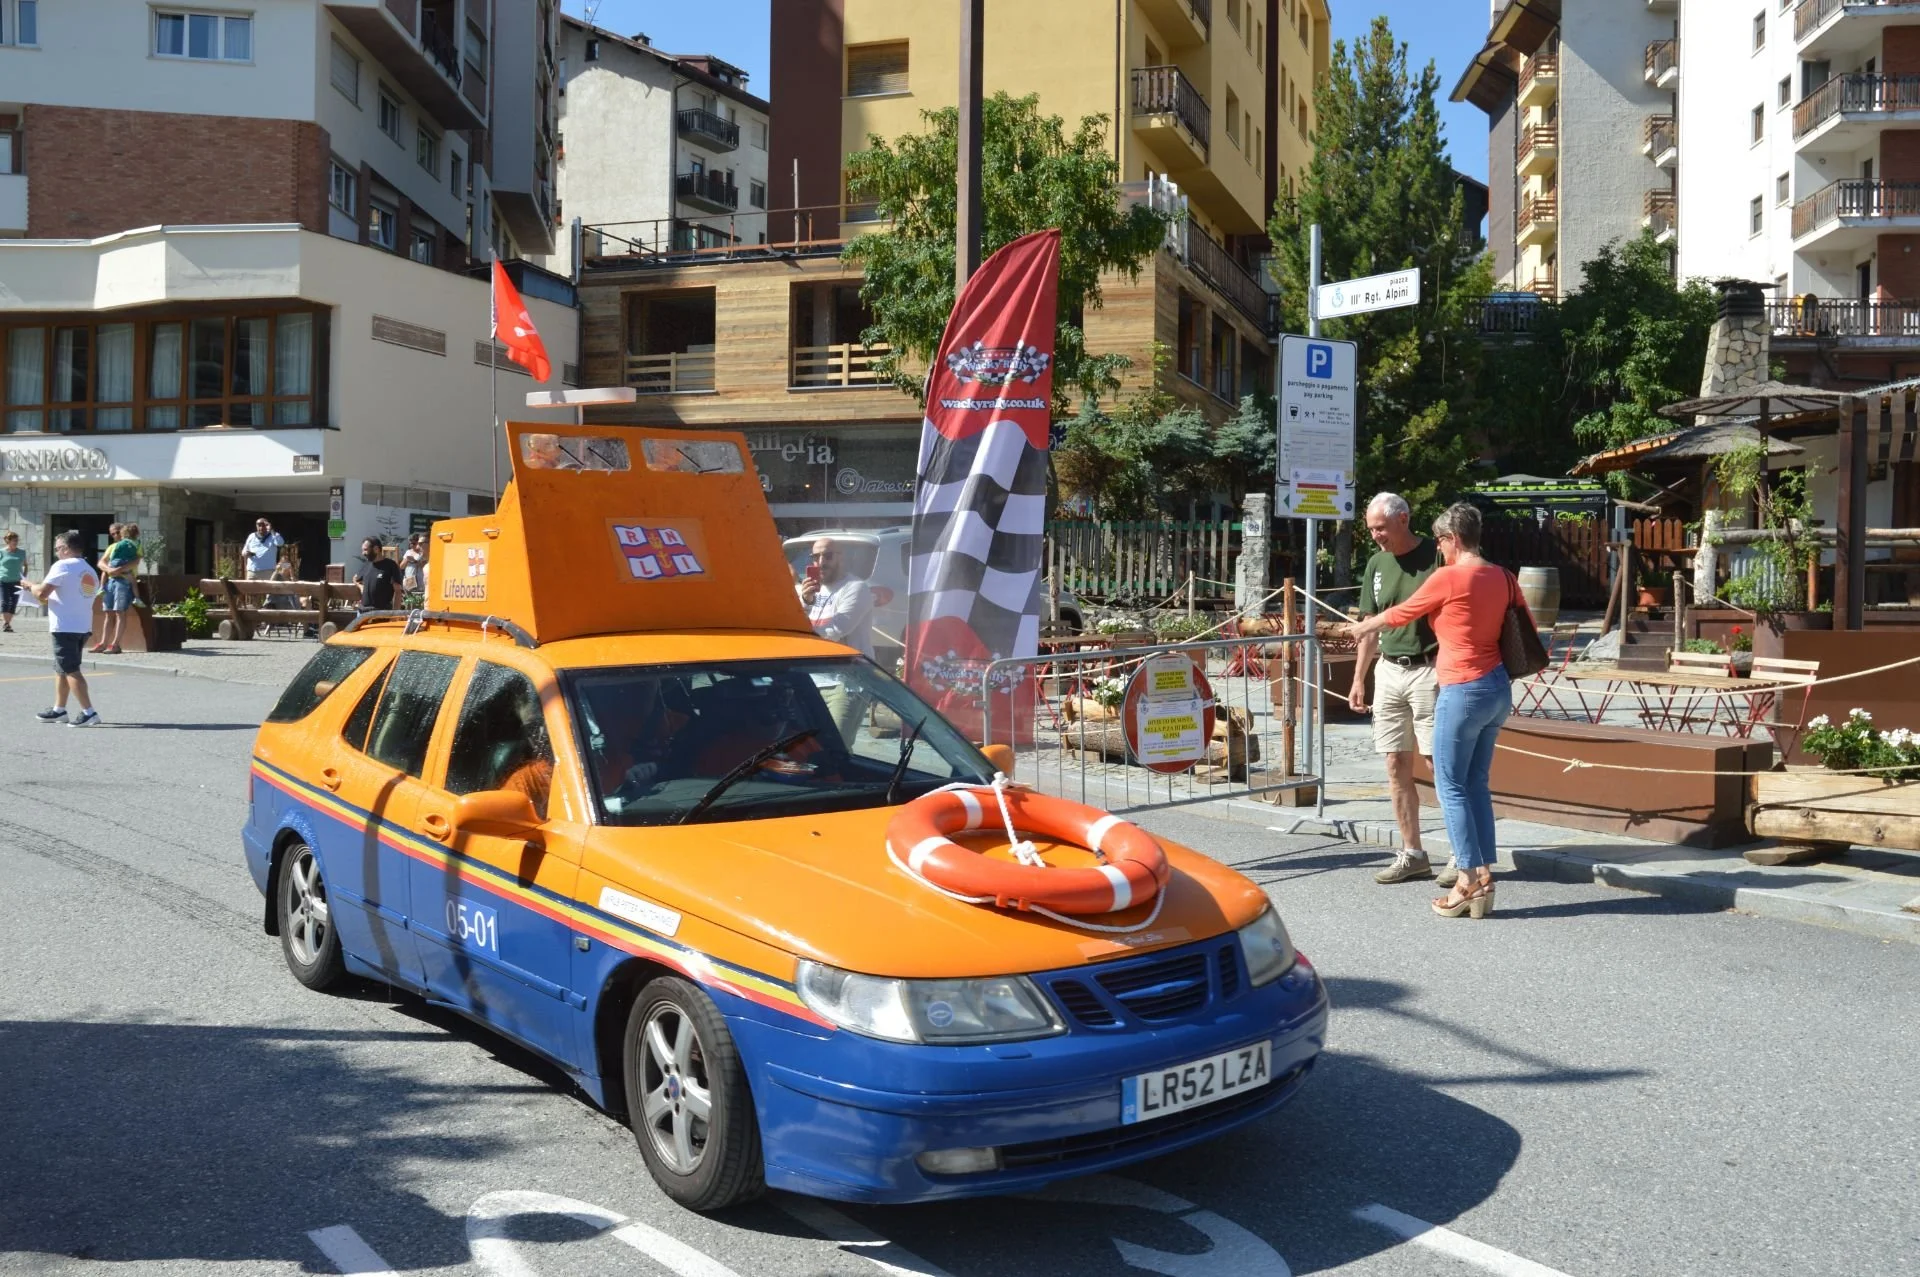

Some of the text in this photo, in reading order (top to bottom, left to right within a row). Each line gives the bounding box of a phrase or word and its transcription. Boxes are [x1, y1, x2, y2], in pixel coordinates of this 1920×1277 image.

[1390, 276, 1408, 286] piazza
[1365, 292, 1381, 304] Rgt.
[1386, 286, 1408, 301] Alpini
[965, 359, 1000, 371] Wacky
[1311, 348, 1327, 374] P
[1287, 380, 1316, 389] parcheggio
[940, 397, 1046, 411] wackyrally.co.uk
[1314, 392, 1334, 401] parking
[7, 447, 106, 472] SANPAOLO
[444, 578, 486, 599] Lifeboats
[446, 900, 497, 952] 05-01
[1143, 1047, 1266, 1112] LR52 LZA
